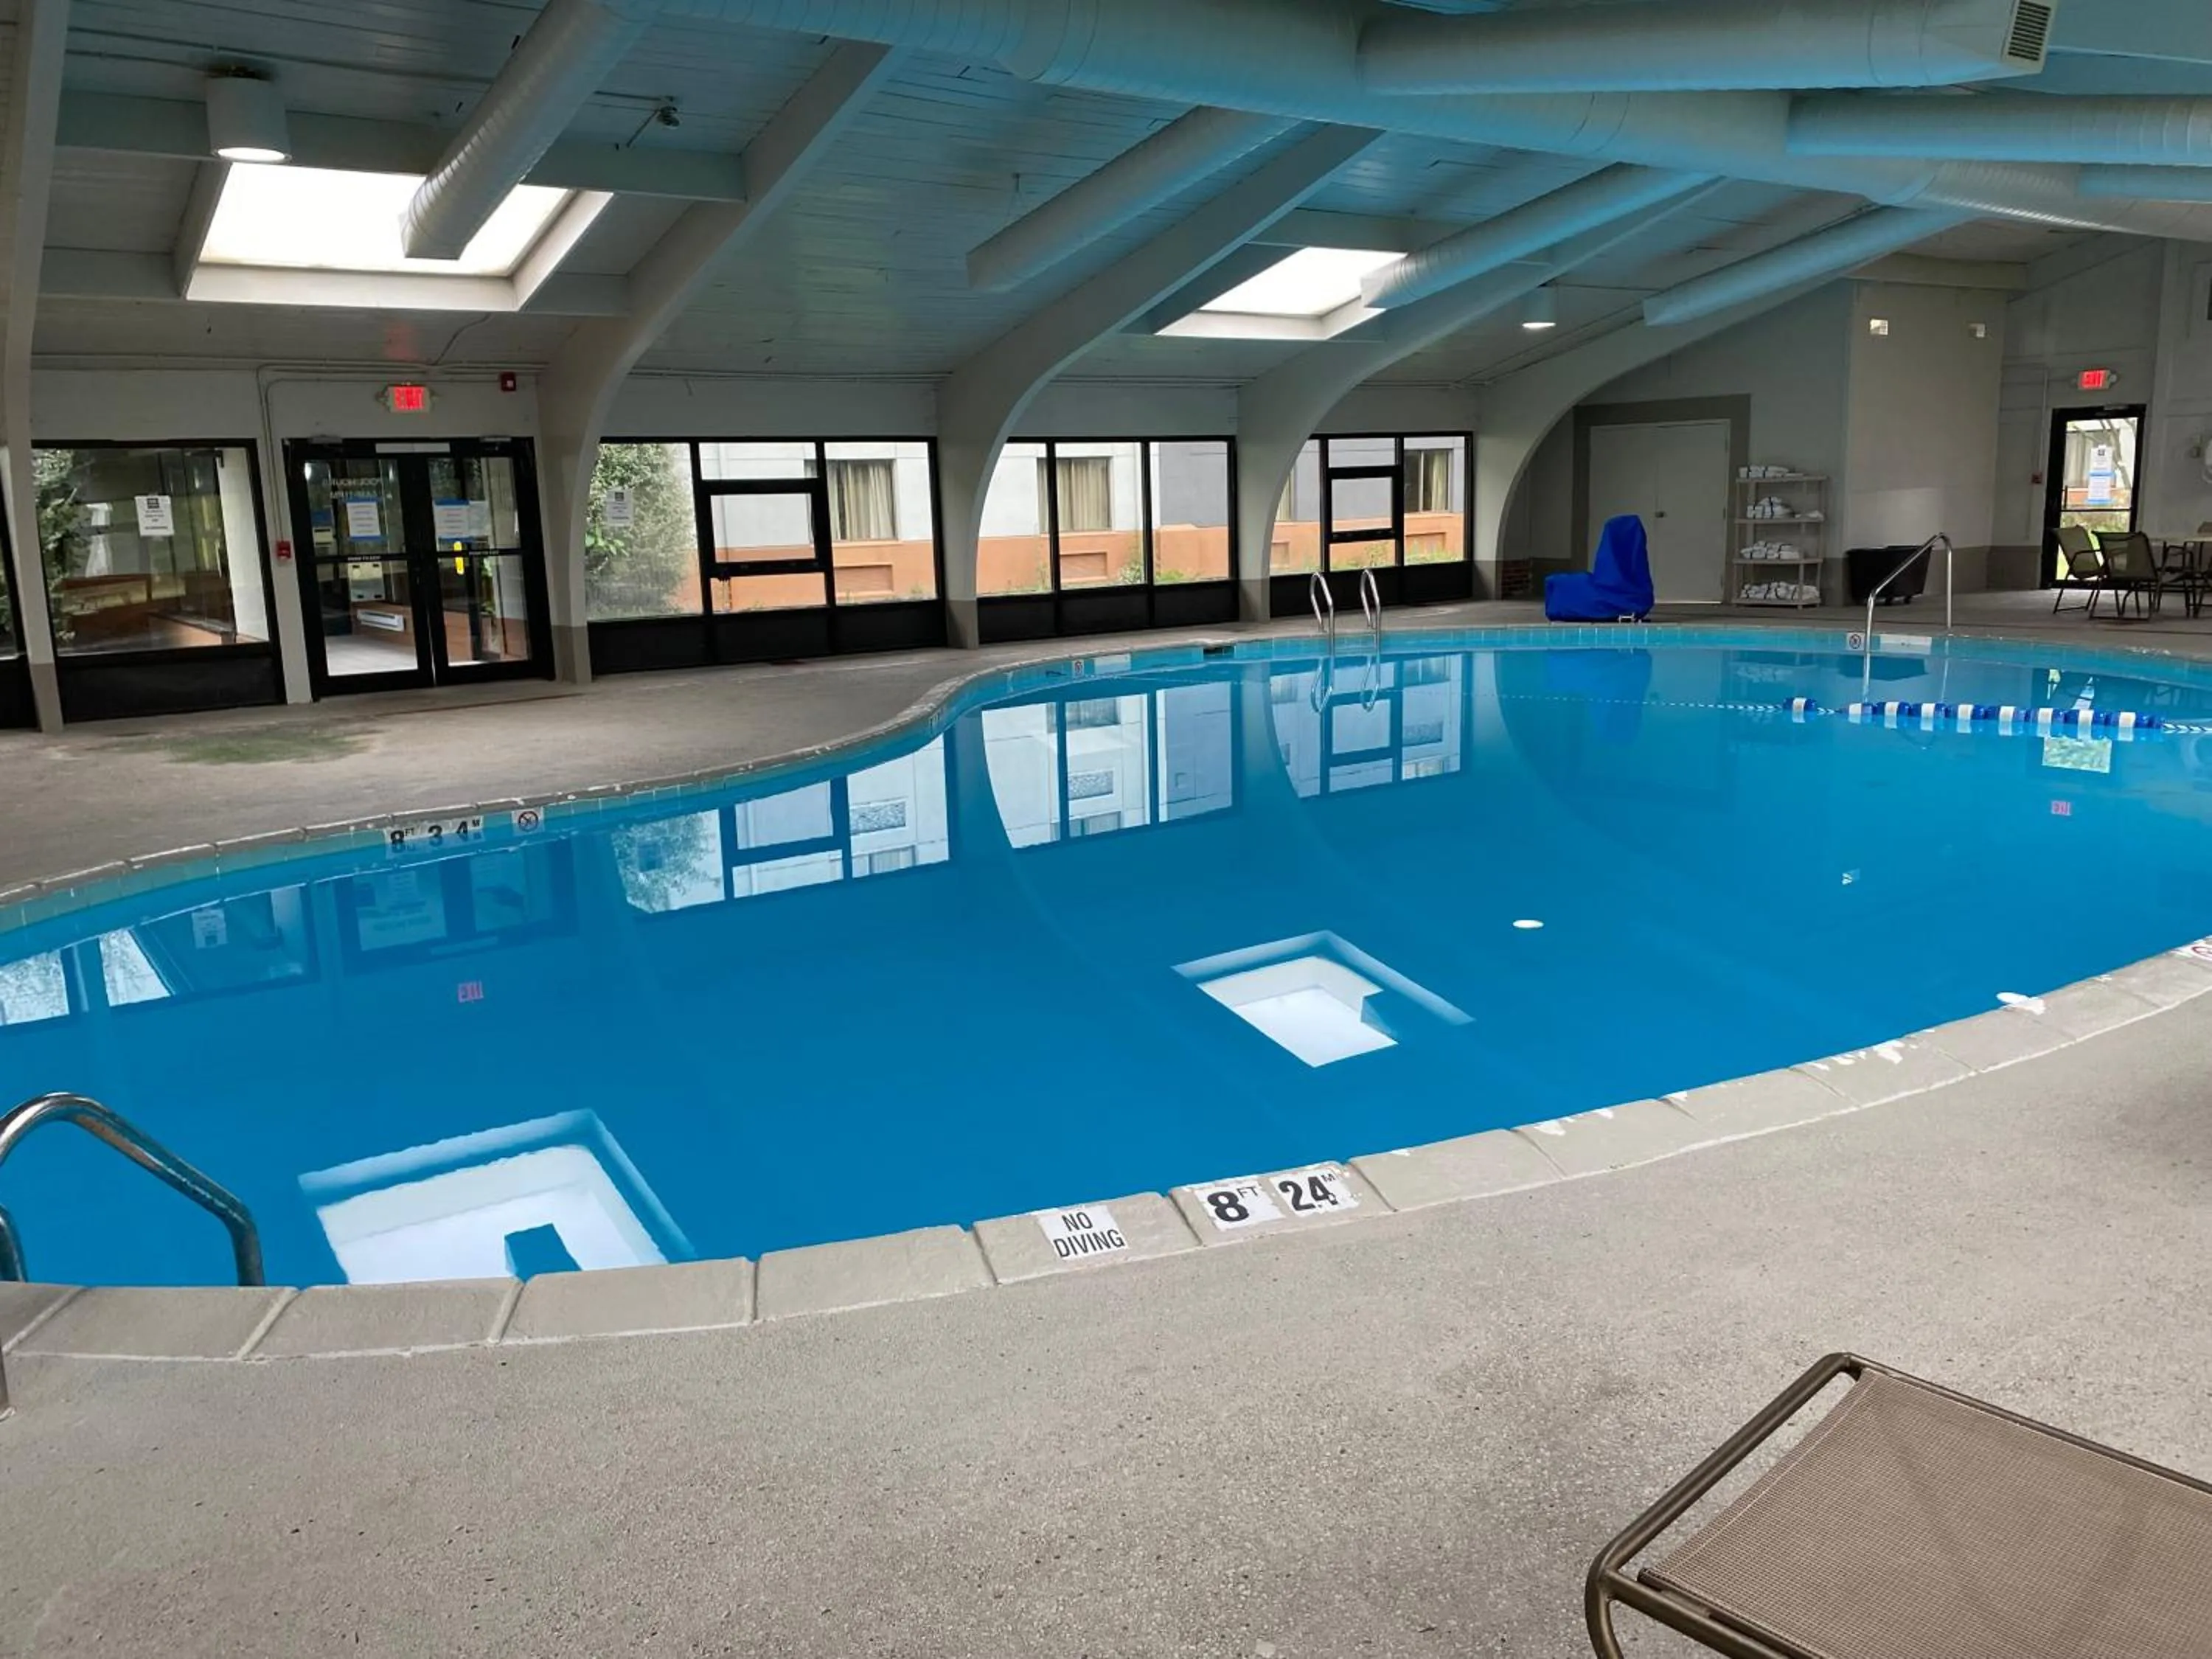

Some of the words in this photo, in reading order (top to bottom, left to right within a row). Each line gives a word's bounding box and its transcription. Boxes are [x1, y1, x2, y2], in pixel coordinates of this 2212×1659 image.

[1207, 1191, 1250, 1222] 8
[1062, 1211, 1093, 1231] NO
[1053, 1229, 1125, 1256] DIVING
